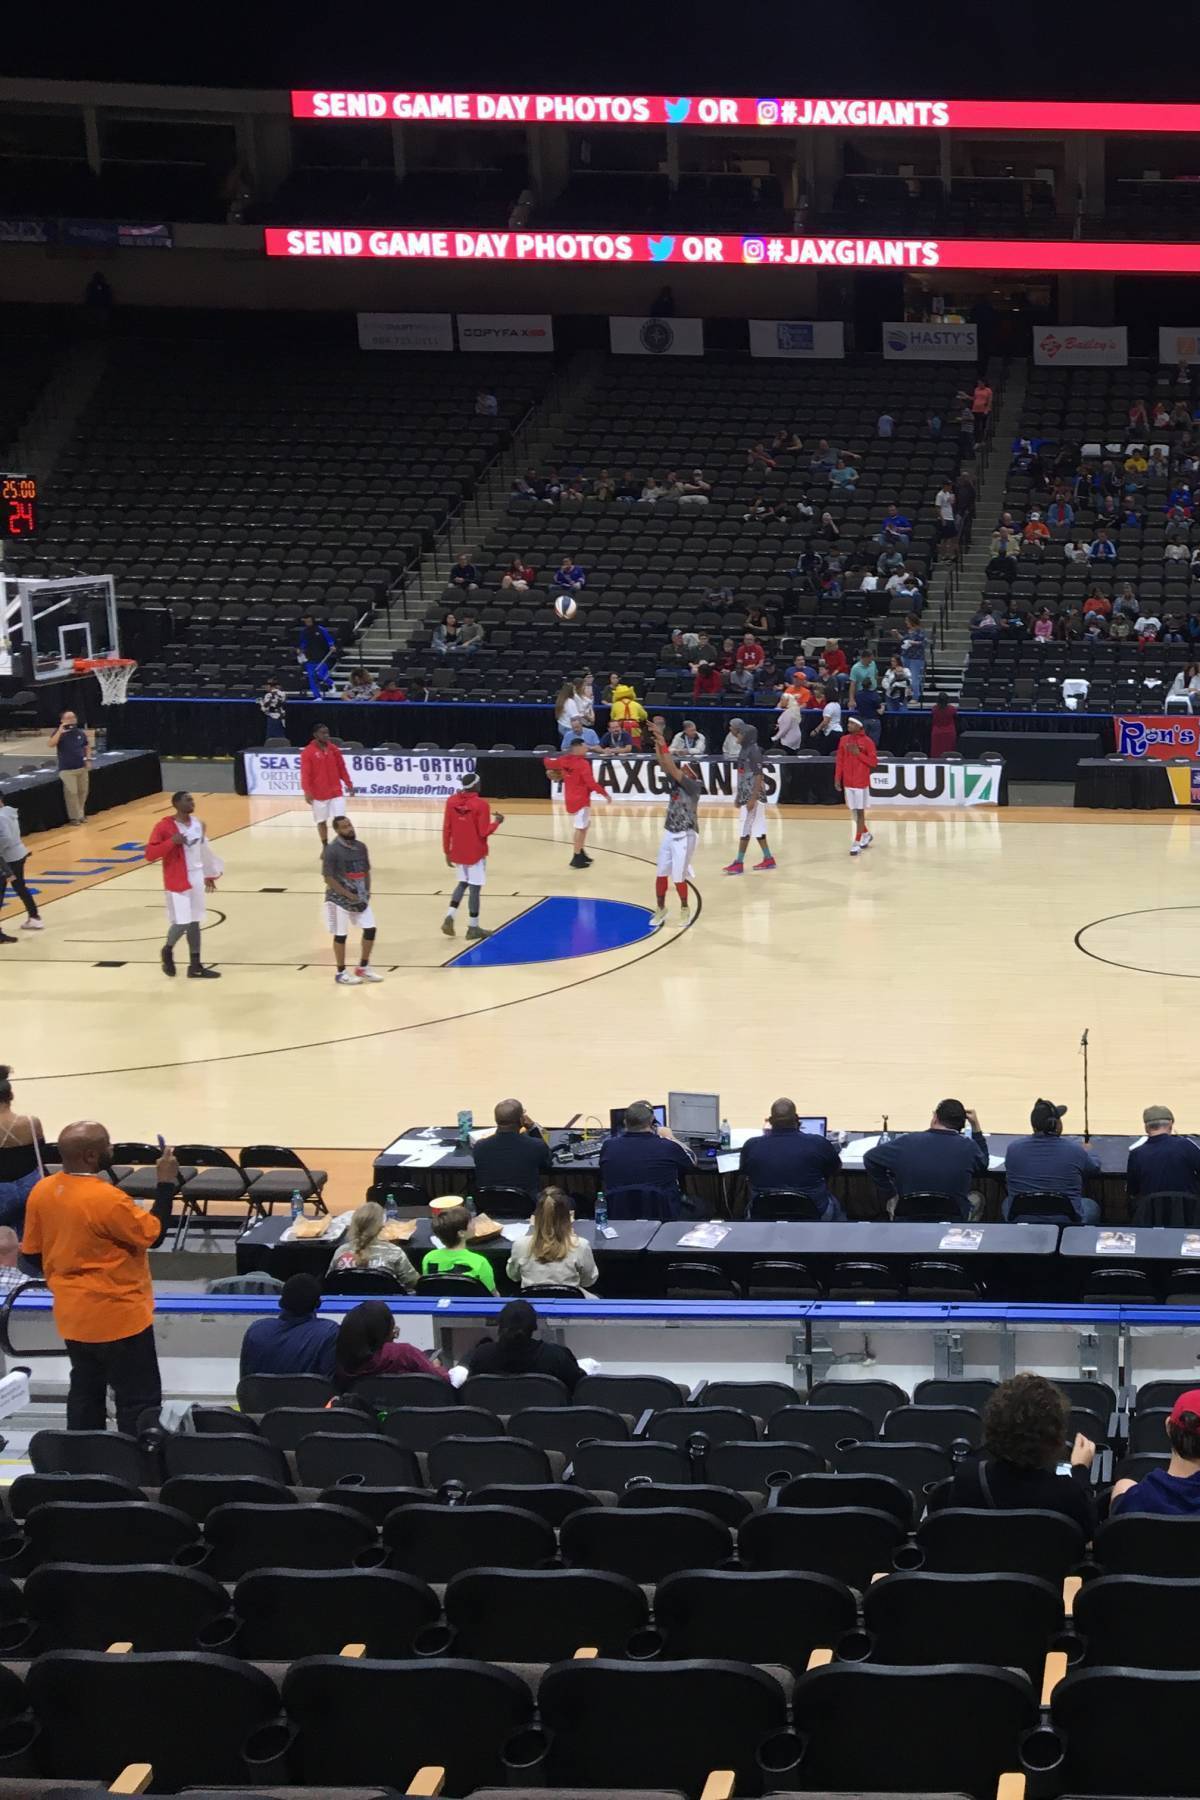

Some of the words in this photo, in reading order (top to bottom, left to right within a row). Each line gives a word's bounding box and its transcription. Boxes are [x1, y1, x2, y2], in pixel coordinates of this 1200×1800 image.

[312, 92, 387, 118] SEND
[392, 93, 471, 119] GAME
[476, 95, 530, 120] DAY
[535, 95, 650, 122] PHOTOS
[697, 98, 739, 123] OR
[780, 100, 950, 127] #JAXGIANTS
[287, 230, 363, 256] SEND
[368, 231, 449, 257] GAME
[455, 233, 510, 258] DAY
[515, 234, 633, 261] PHOTOS
[682, 236, 724, 262] OR
[766, 239, 940, 267] #JAXGIANTS
[910, 331, 976, 345] HASTY'S
[2, 480, 36, 499] 25:00
[8, 501, 34, 533] 24
[1119, 718, 1195, 757] Ron's
[259, 756, 290, 769] SEA
[352, 757, 477, 773] 866-81-ORTHO
[873, 777, 889, 785] THE
[950, 765, 993, 801] 17
